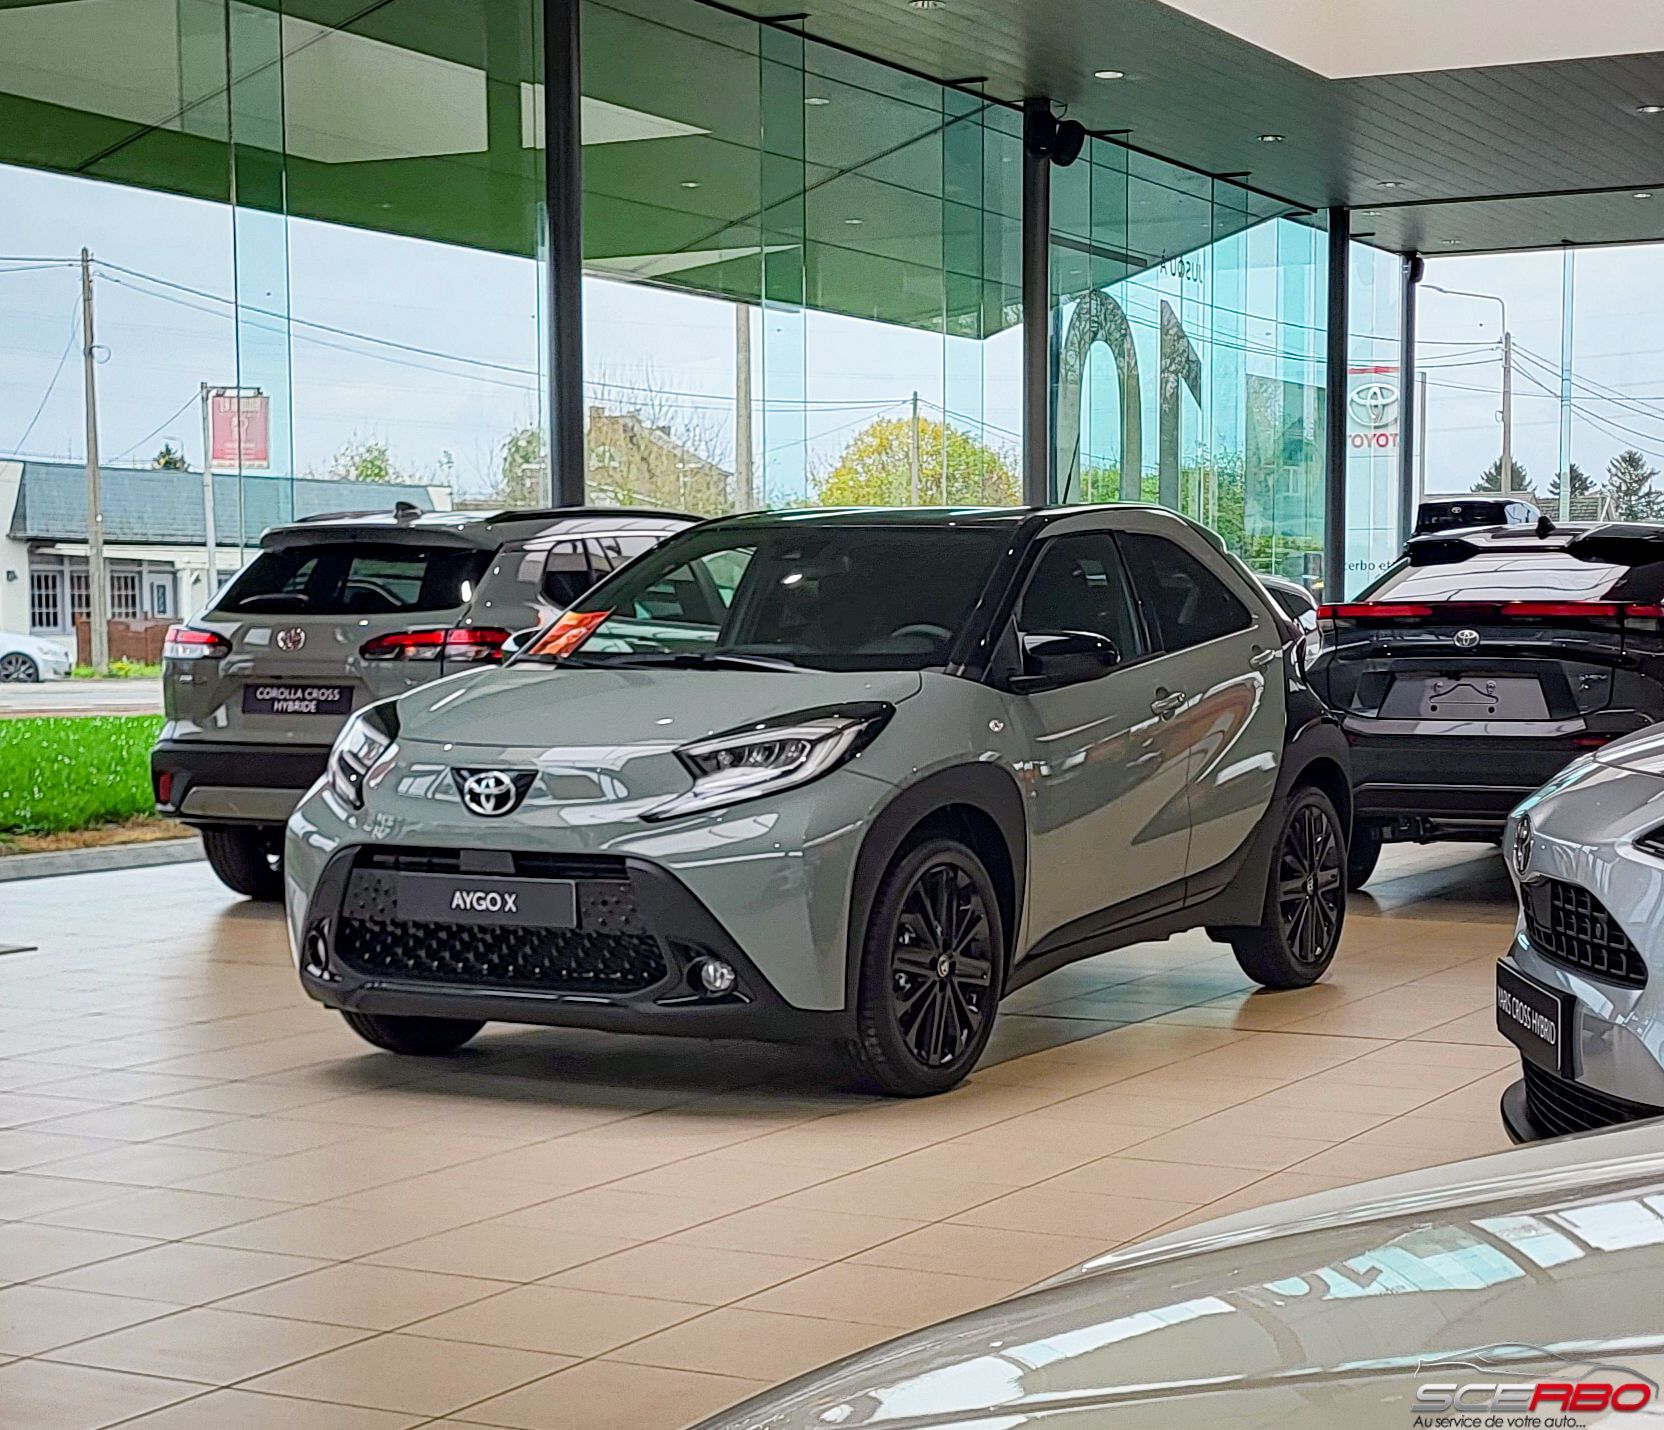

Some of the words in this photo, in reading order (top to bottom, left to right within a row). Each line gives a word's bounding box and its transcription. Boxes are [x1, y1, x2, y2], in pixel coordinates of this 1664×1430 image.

[1348, 433, 1399, 448] OYOT
[256, 687, 302, 699] COROLLA
[304, 688, 340, 700] CROSS
[273, 700, 317, 713] HYBRIDE
[451, 890, 502, 911] AYGO
[504, 893, 517, 912] X
[1532, 1009, 1556, 1045] HYBRID
